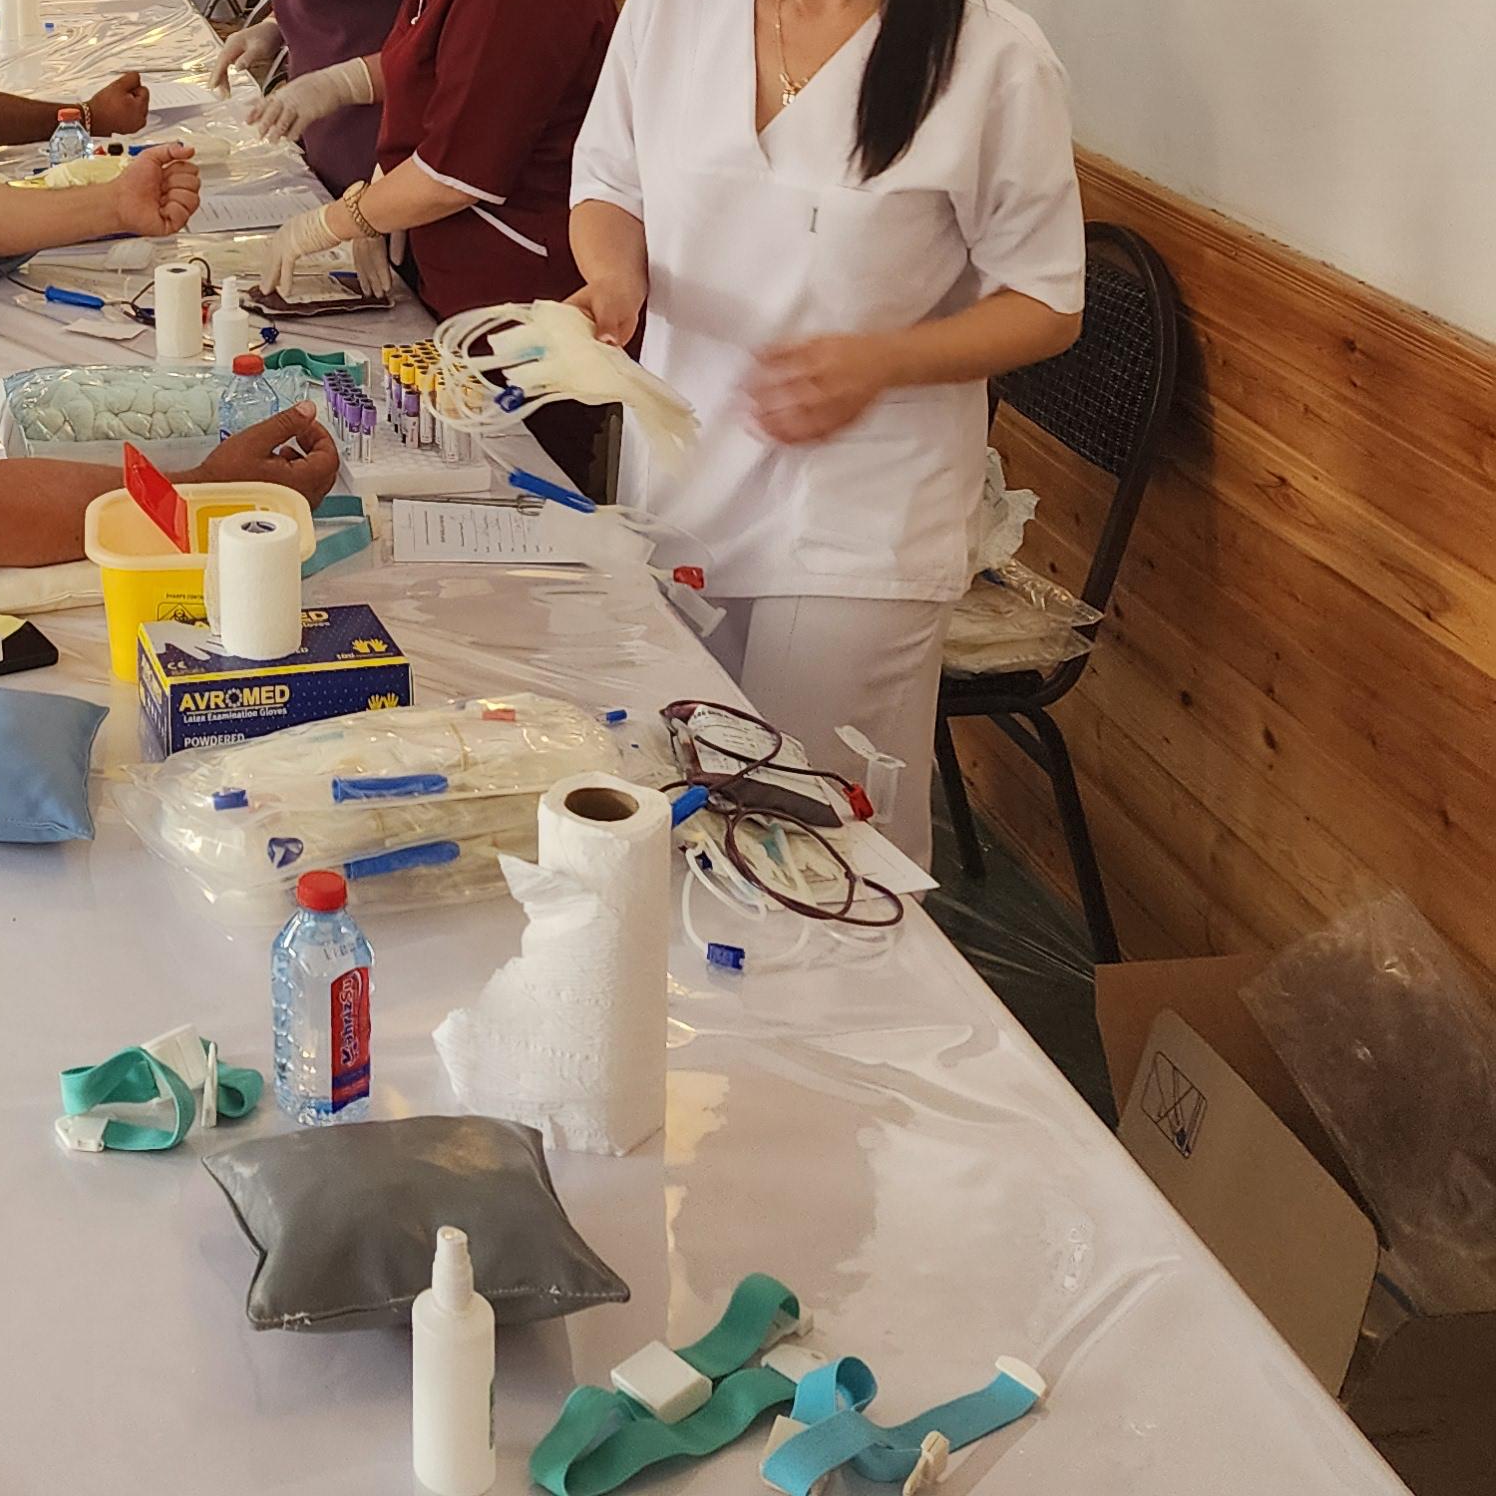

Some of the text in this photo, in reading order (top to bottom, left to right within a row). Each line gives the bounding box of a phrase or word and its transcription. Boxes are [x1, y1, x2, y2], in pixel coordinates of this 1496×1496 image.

[179, 685, 291, 712] AVROMED
[183, 707, 288, 724] Latex Examination Gloves
[184, 733, 246, 748] POWDERED
